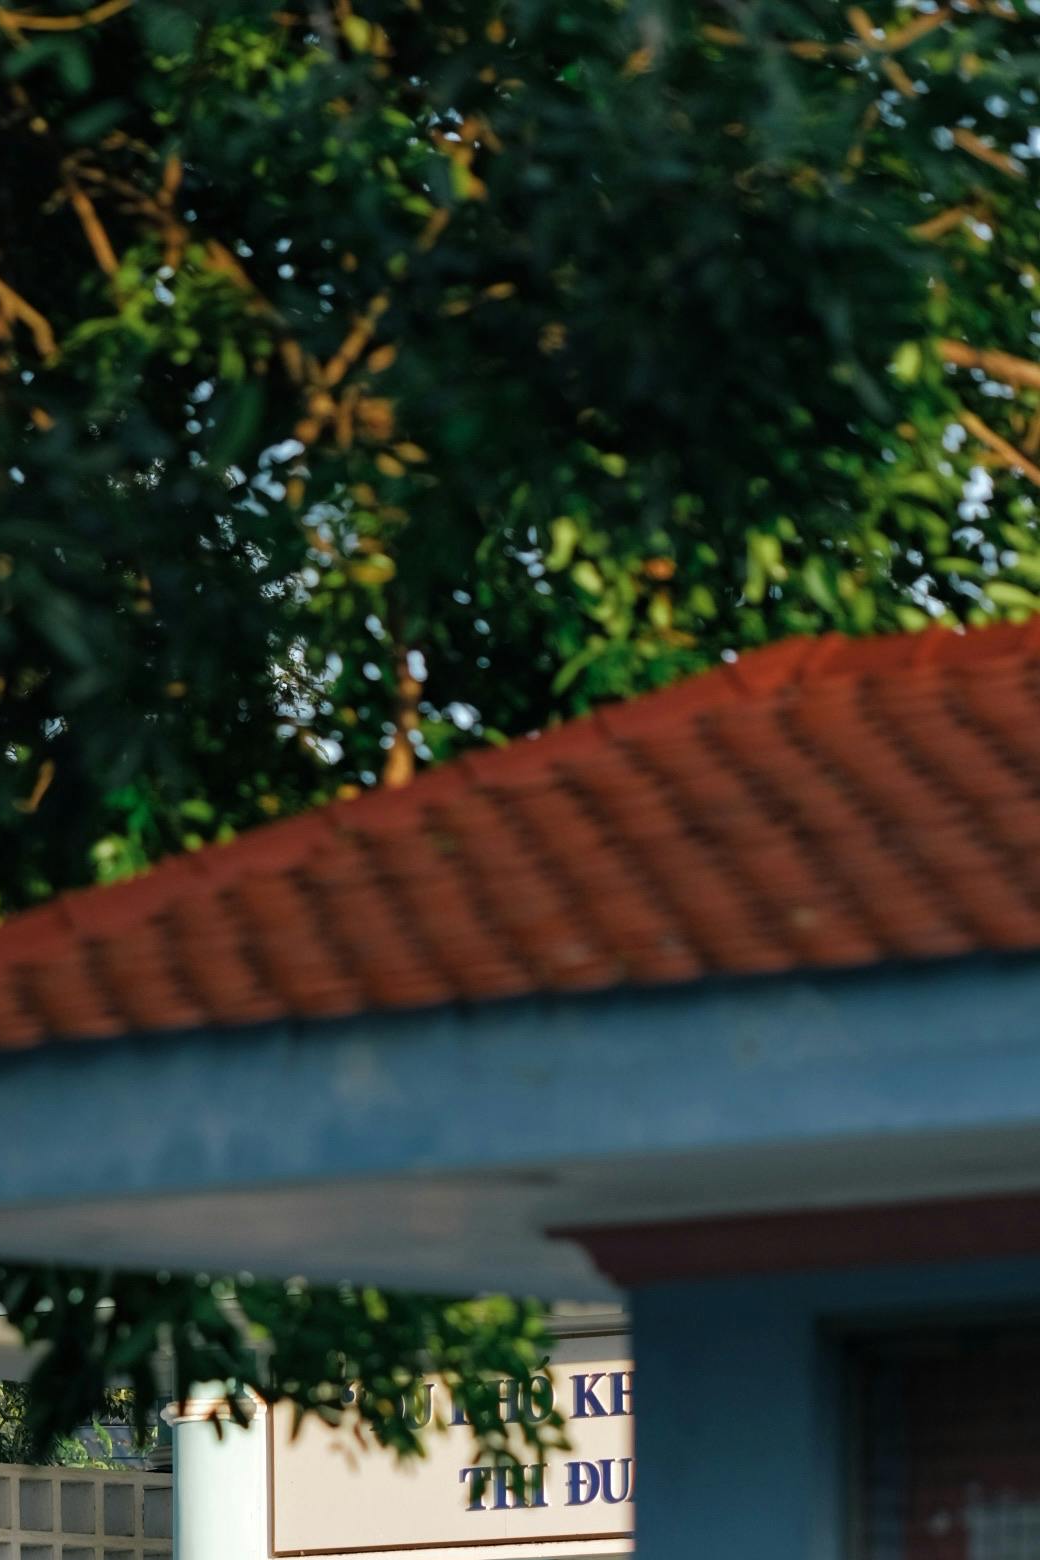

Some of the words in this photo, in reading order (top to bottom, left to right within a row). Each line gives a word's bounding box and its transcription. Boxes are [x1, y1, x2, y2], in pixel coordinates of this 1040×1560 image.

[448, 1355, 555, 1426] HÓ
[458, 1462, 549, 1511] THI
[564, 1457, 636, 1507] ĐU
